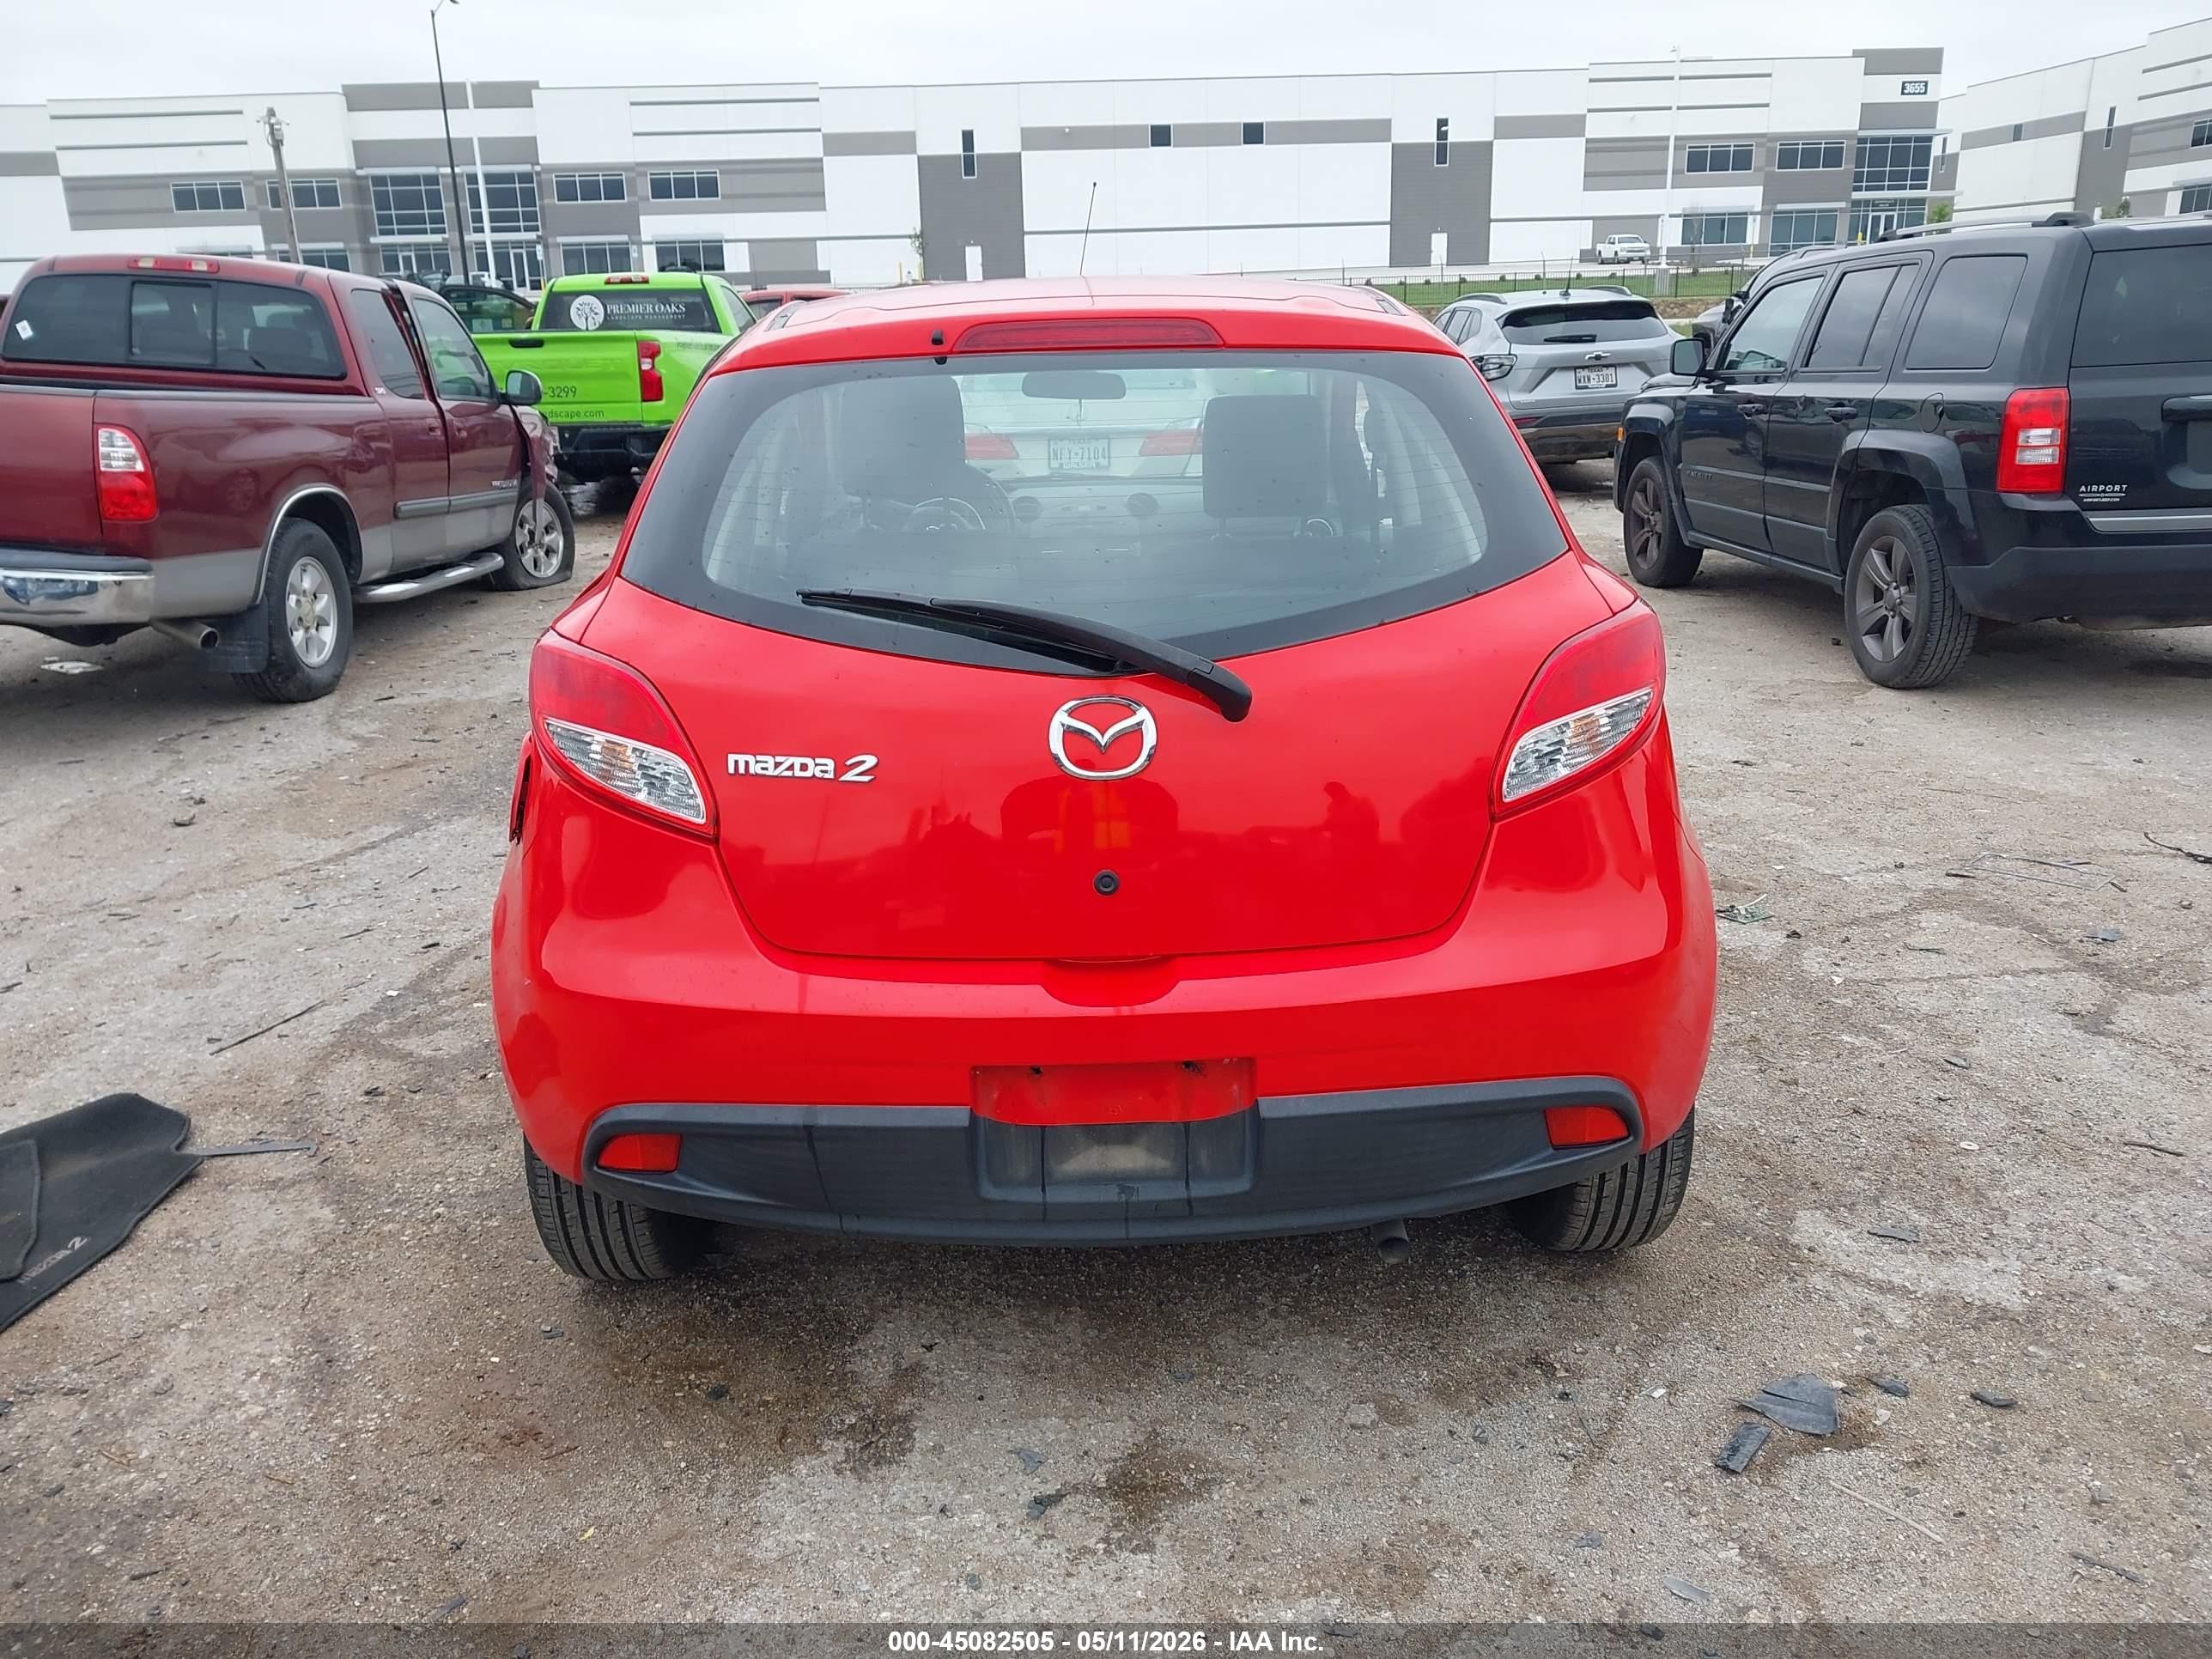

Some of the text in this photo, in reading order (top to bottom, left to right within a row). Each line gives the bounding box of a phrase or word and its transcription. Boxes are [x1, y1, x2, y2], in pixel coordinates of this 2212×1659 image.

[606, 302, 686, 314] PREMIER OAKS
[543, 385, 578, 398] -3299
[838, 753, 879, 783] 2
